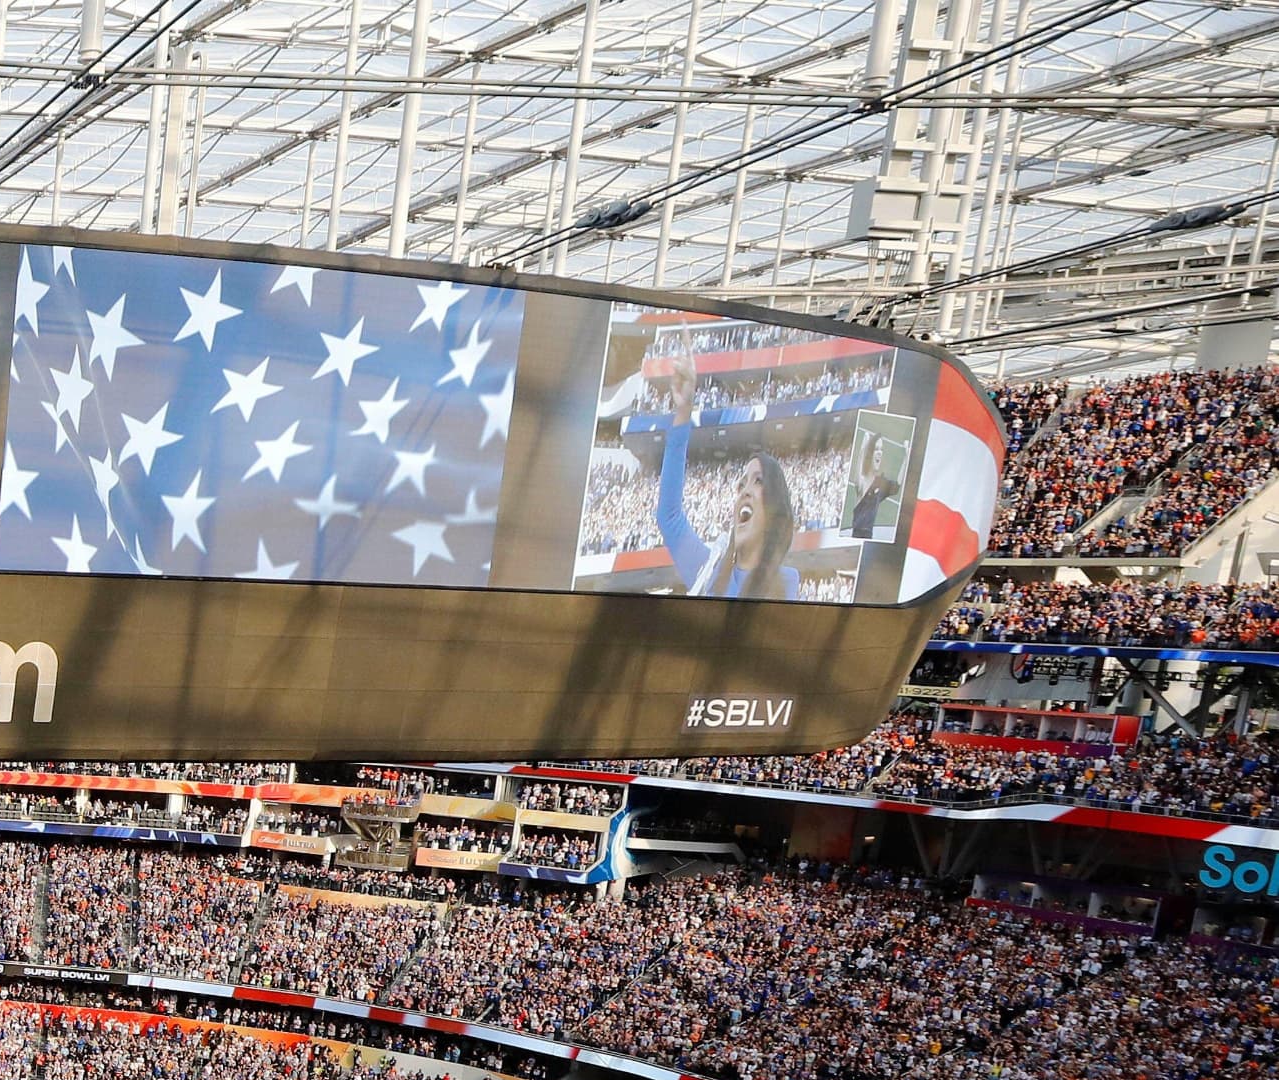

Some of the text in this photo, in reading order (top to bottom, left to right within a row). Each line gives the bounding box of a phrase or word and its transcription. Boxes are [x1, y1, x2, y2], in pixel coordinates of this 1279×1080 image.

[687, 698, 794, 728] #SBLVI
[23, 967, 60, 977] SUPER
[60, 970, 93, 980] BOWL
[94, 973, 110, 981] LVI
